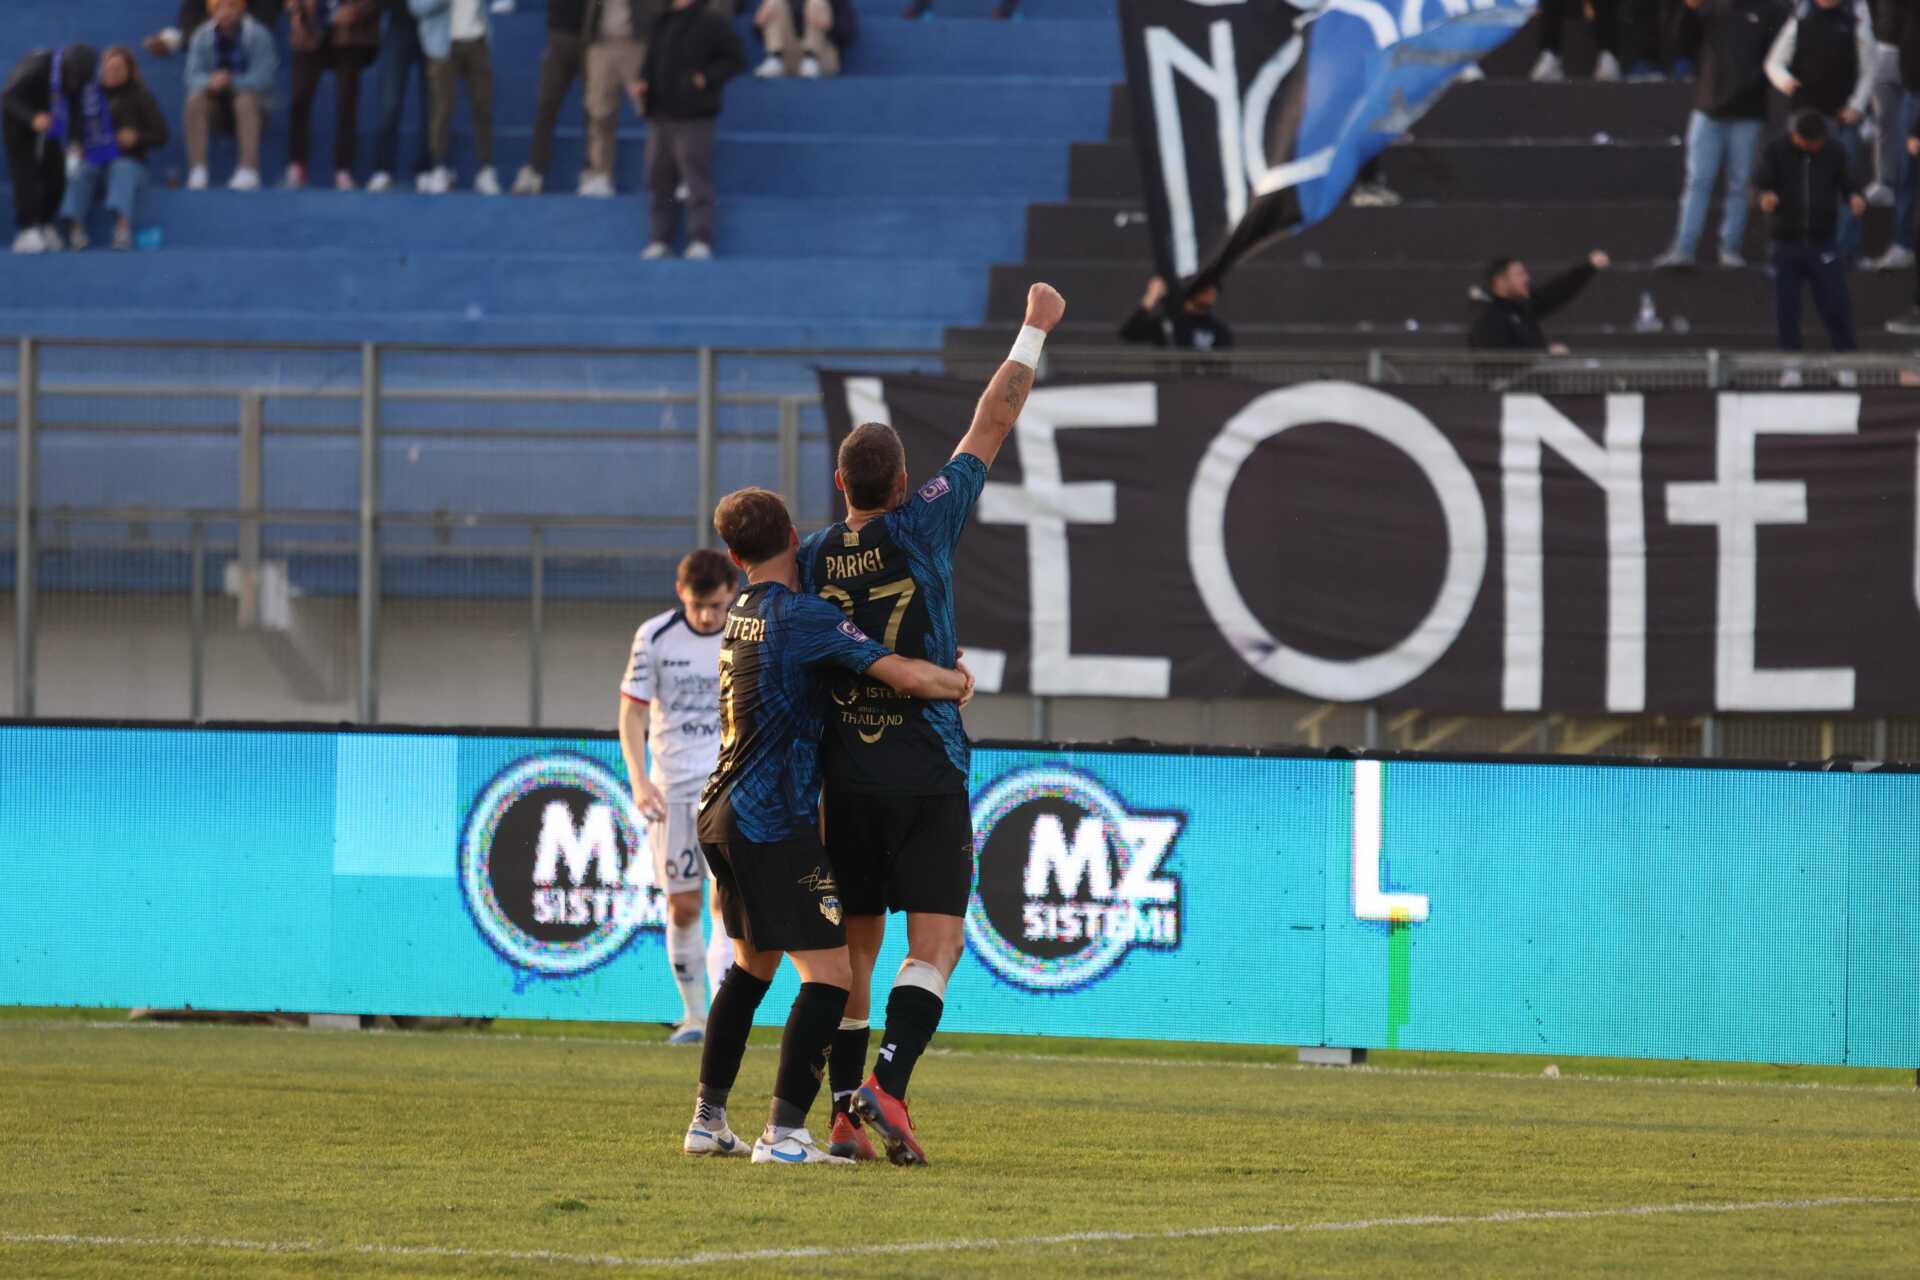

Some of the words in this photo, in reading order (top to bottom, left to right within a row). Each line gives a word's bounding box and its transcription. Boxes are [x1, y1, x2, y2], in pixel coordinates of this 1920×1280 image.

[825, 547, 885, 580] PARIGI
[723, 615, 766, 641] TTERI
[841, 711, 904, 727] THAILAND
[1023, 813, 1180, 898] MZ
[1354, 760, 1429, 922] L
[532, 886, 668, 924] SISTEM
[1022, 901, 1178, 943] SISTEMI
